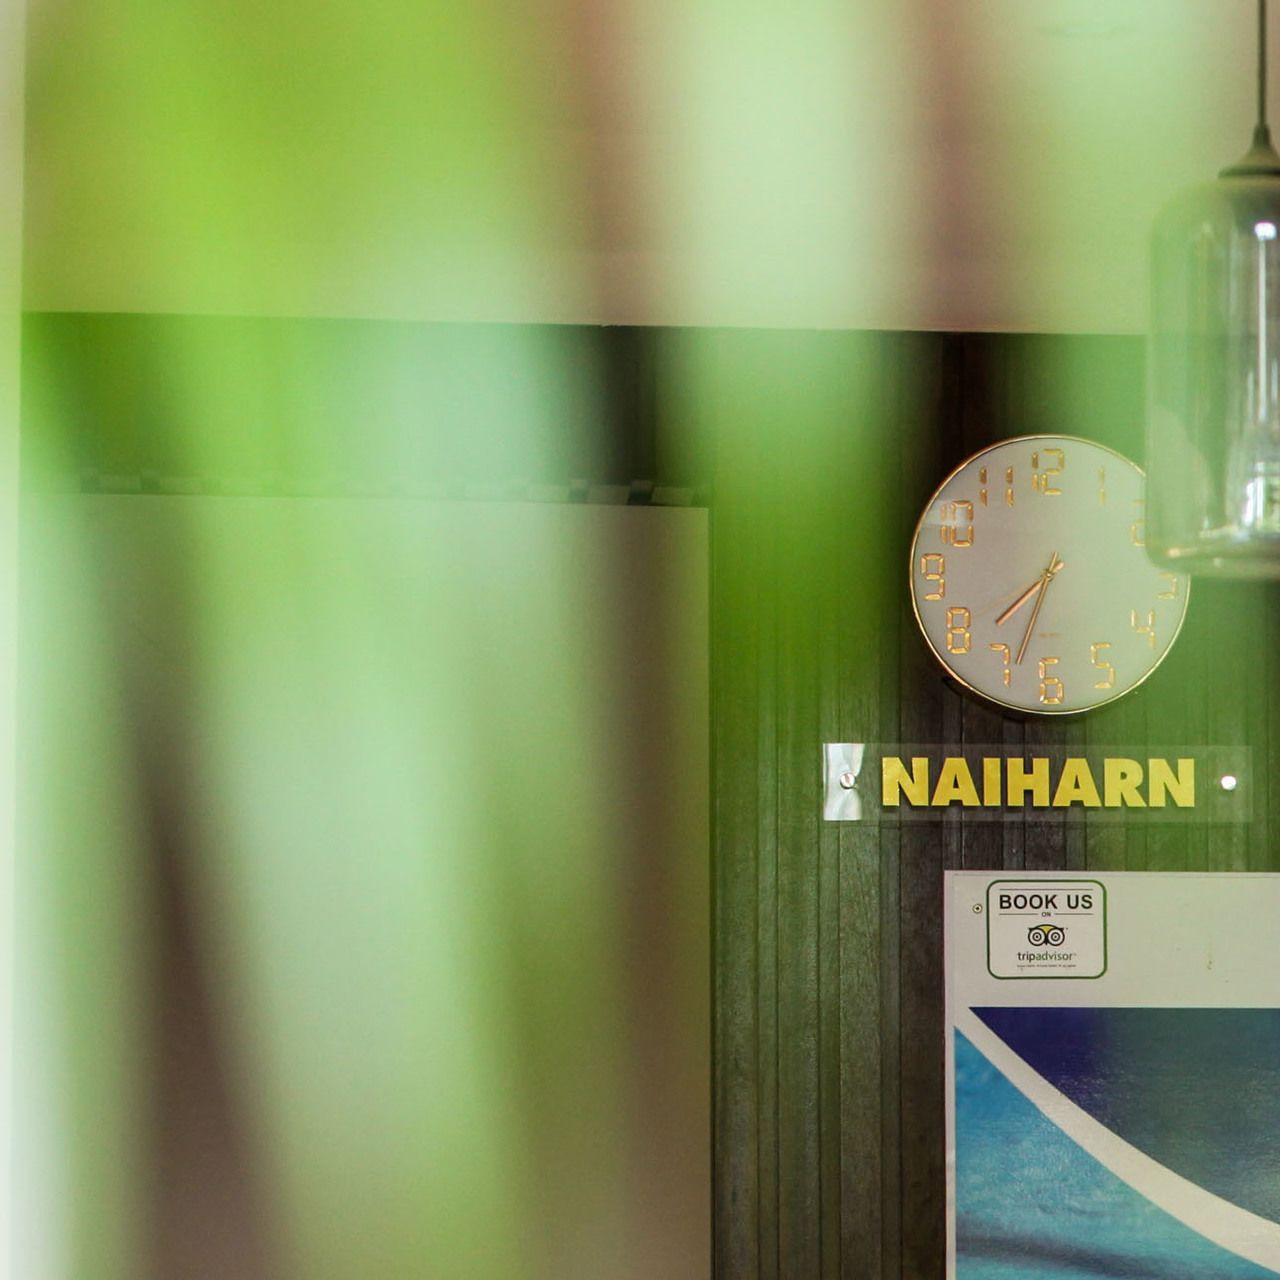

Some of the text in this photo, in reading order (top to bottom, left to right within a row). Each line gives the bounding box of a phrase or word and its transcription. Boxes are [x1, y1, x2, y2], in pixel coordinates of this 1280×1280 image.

[979, 466, 1015, 507] 11
[1032, 448, 1064, 496] 12
[940, 500, 974, 548] 10
[921, 553, 945, 601] 9
[946, 607, 971, 655] 8
[1131, 608, 1155, 648] 4
[990, 643, 1011, 688] 7
[1039, 658, 1064, 705] 6
[1091, 642, 1115, 689] 5
[881, 756, 1196, 809] NAIHARN
[999, 894, 1093, 910] BOOK US
[1017, 950, 1073, 963] tripadvisor
